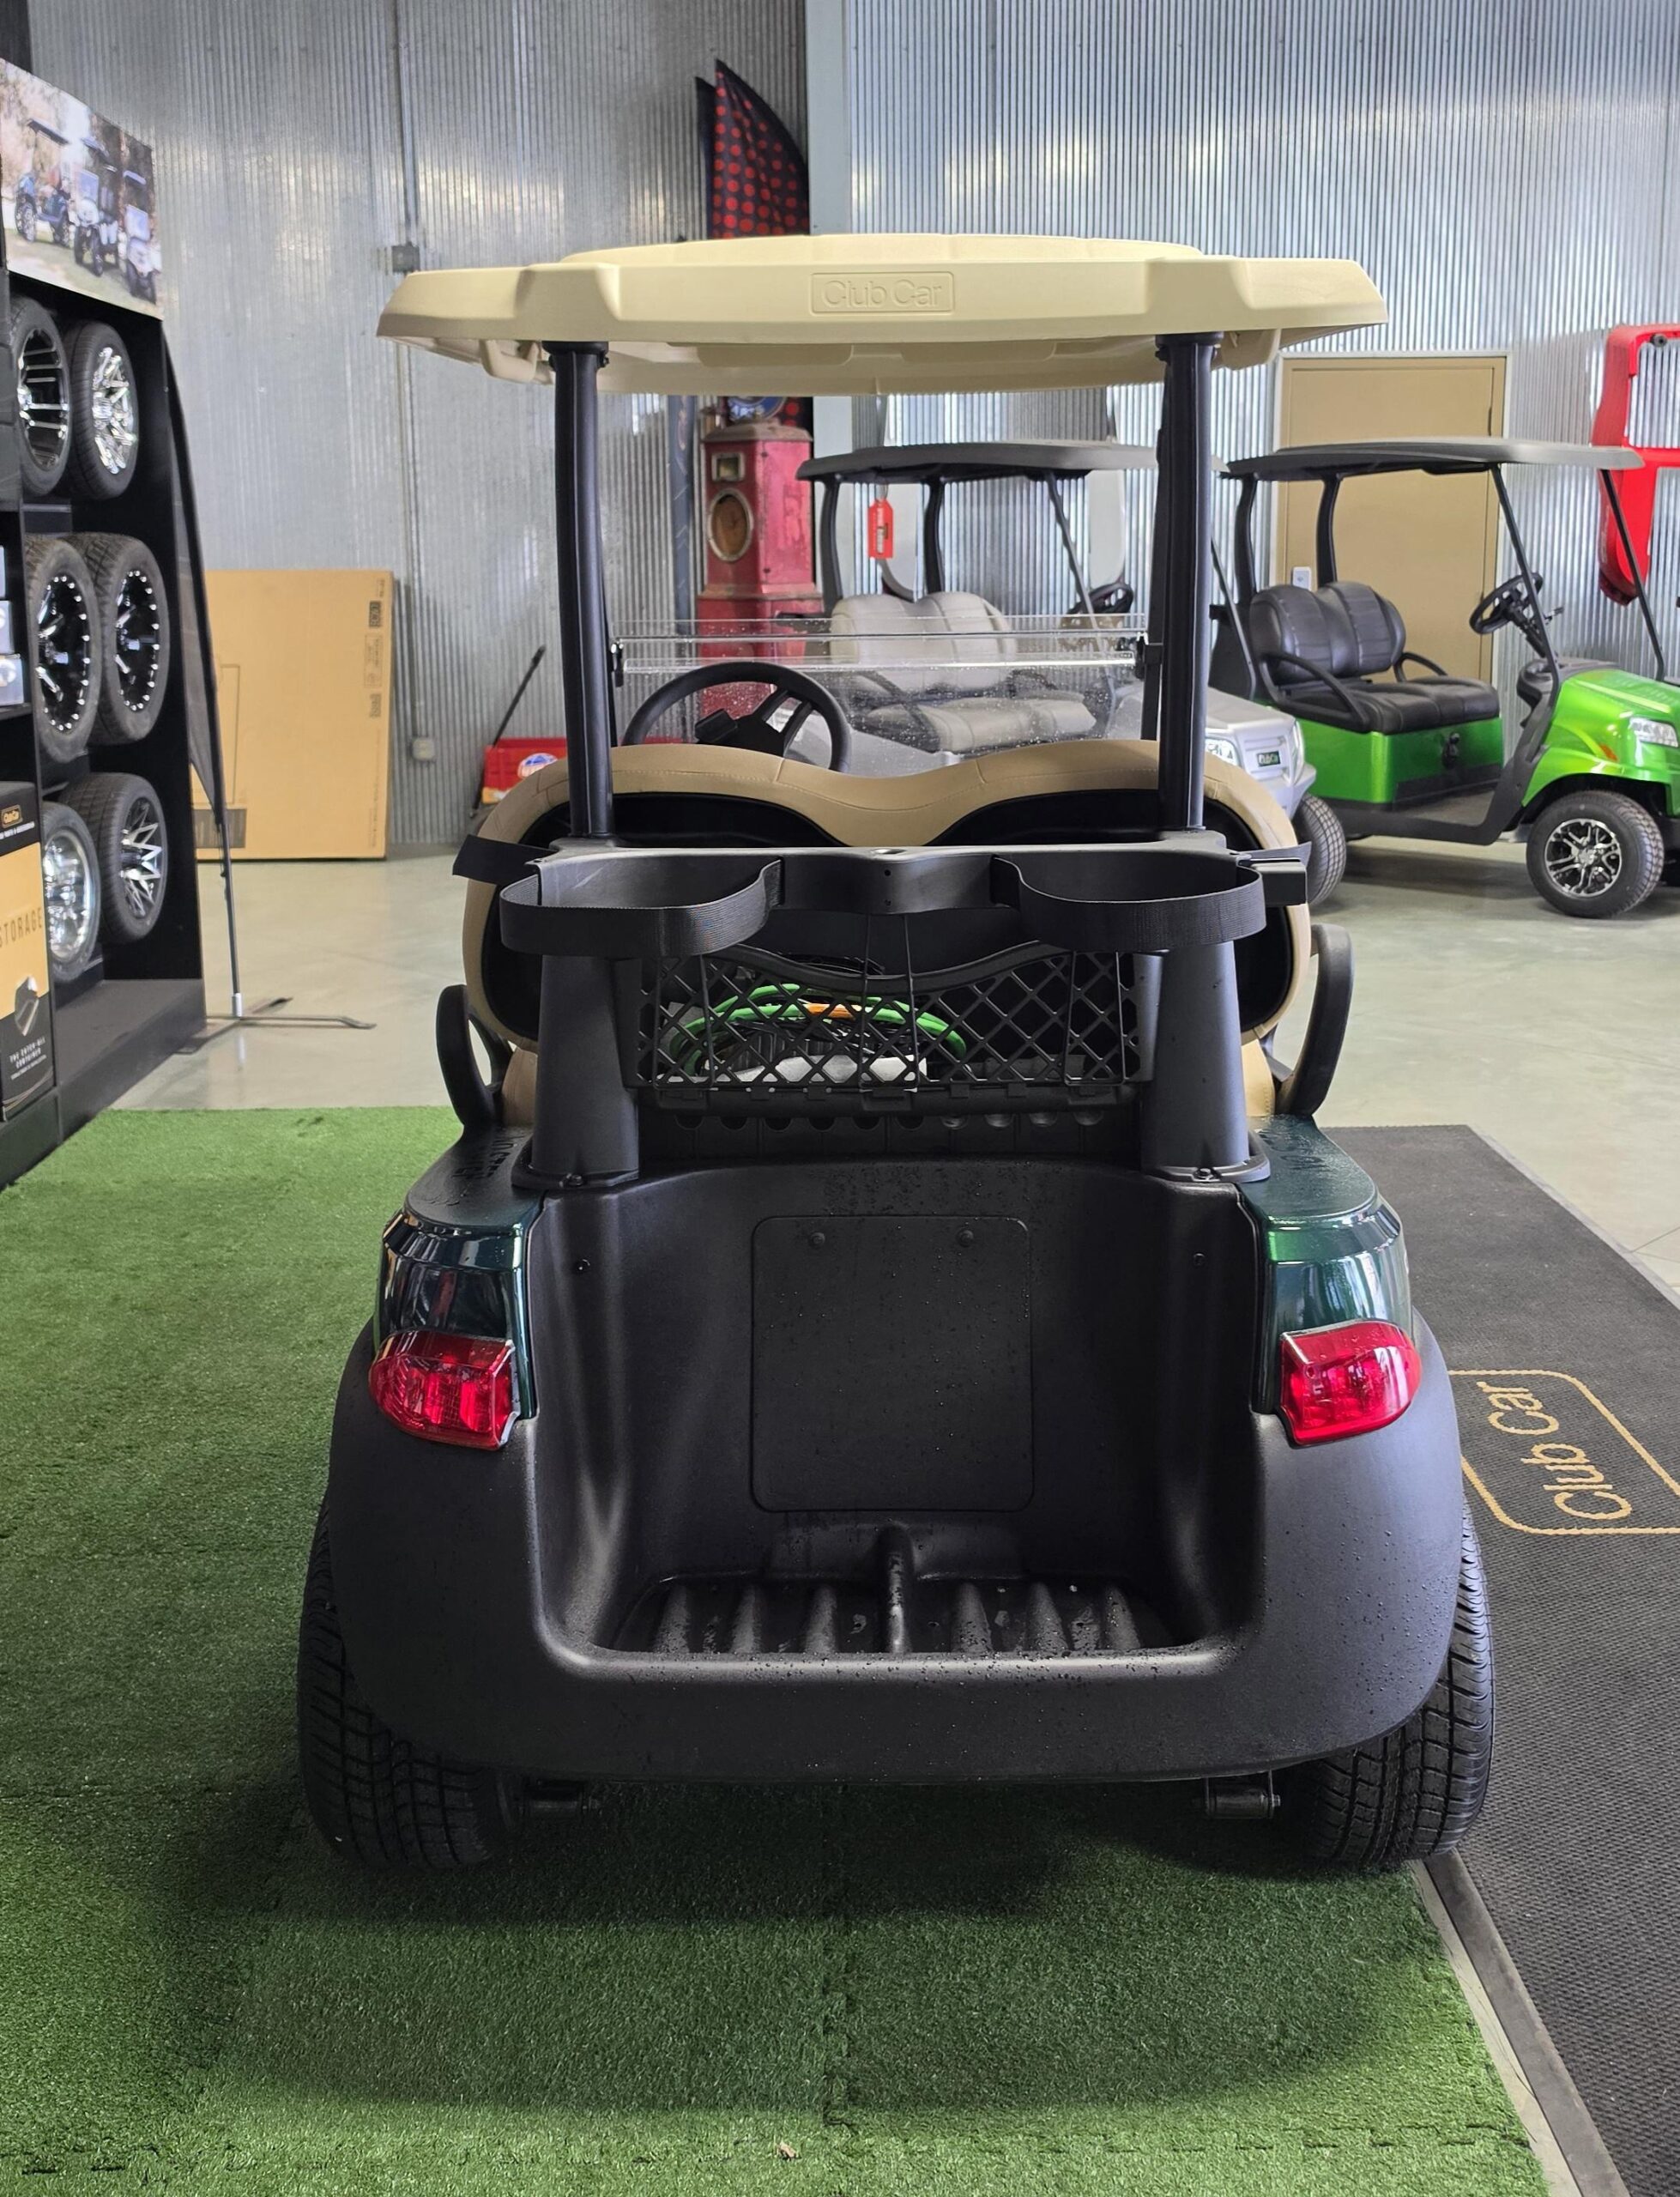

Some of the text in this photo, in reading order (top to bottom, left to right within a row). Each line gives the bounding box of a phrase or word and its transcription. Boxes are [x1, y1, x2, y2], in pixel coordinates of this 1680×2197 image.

[823, 278, 942, 307] Club Car
[1477, 1381, 1632, 1520] Club Car
